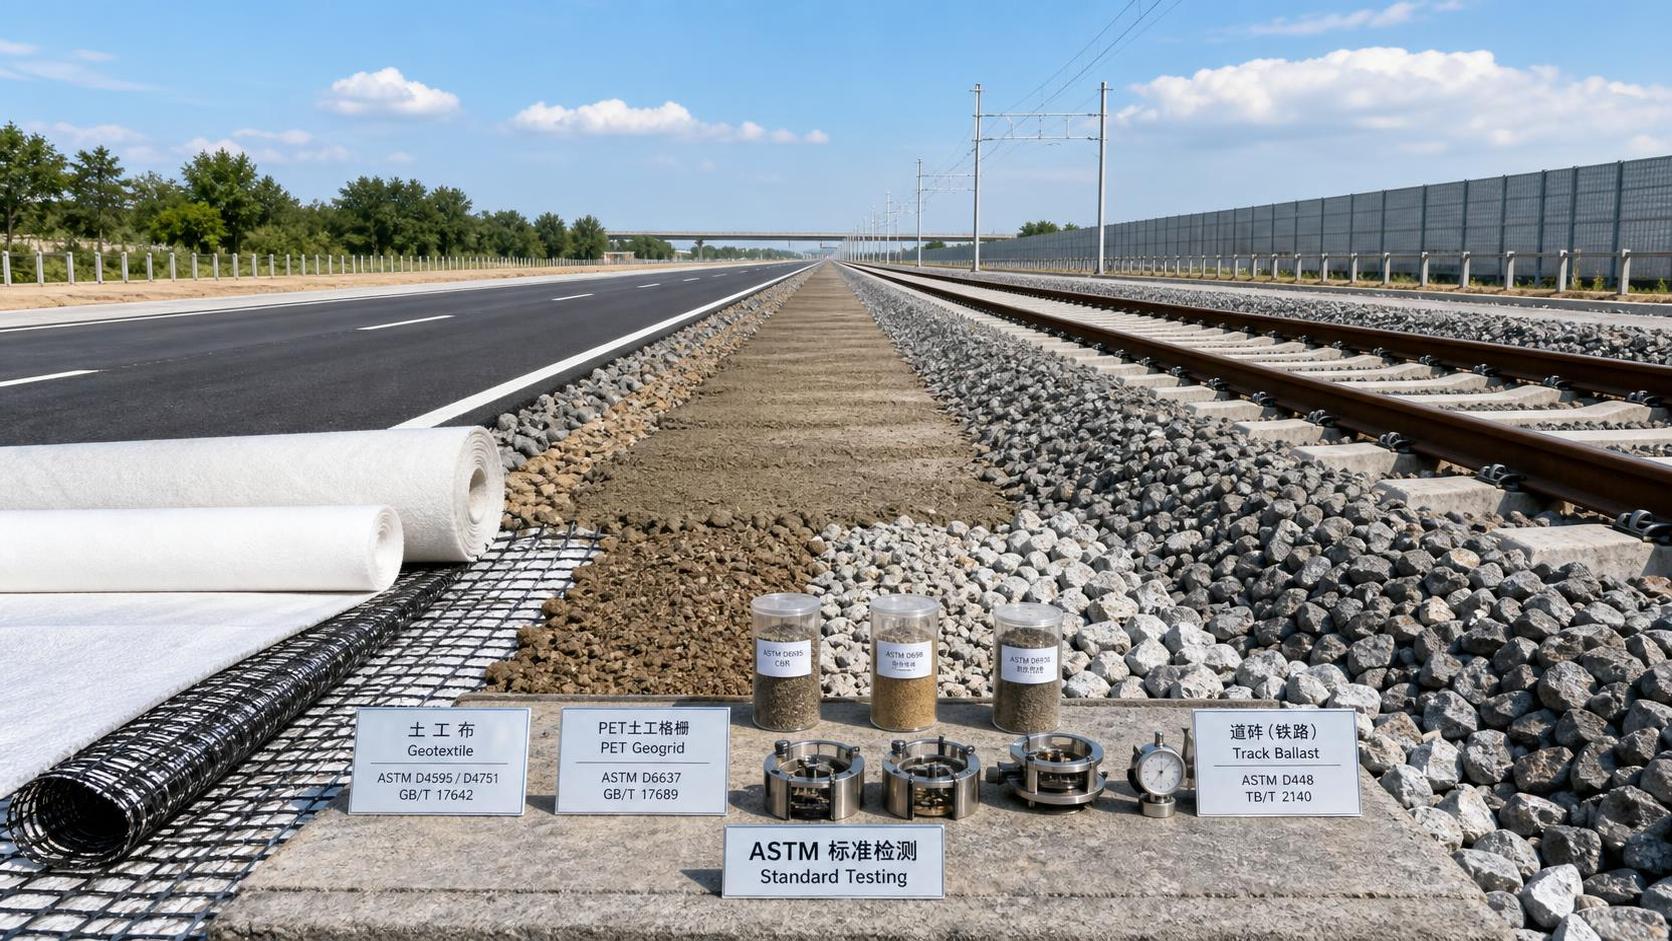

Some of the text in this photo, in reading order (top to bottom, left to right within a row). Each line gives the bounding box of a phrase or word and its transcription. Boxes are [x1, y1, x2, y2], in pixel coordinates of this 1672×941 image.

[408, 721, 475, 738] 土工布
[599, 719, 690, 736] PET土工格栅
[407, 745, 473, 757] Geotextile
[600, 742, 685, 757] PET Geogrid
[1233, 747, 1319, 760] Track Ballast
[377, 773, 411, 784] ASTM
[416, 773, 453, 784] D4595
[464, 773, 498, 784] D4751
[602, 772, 682, 784] ASTM D6637
[1242, 775, 1314, 786] ASTM D448
[400, 789, 474, 802] GB/T 17642
[604, 789, 678, 801] GB/T 17689
[1246, 791, 1312, 803] TB/T 2140
[749, 840, 917, 861] ASTM 标准检测
[761, 869, 907, 888] Standard Testing
